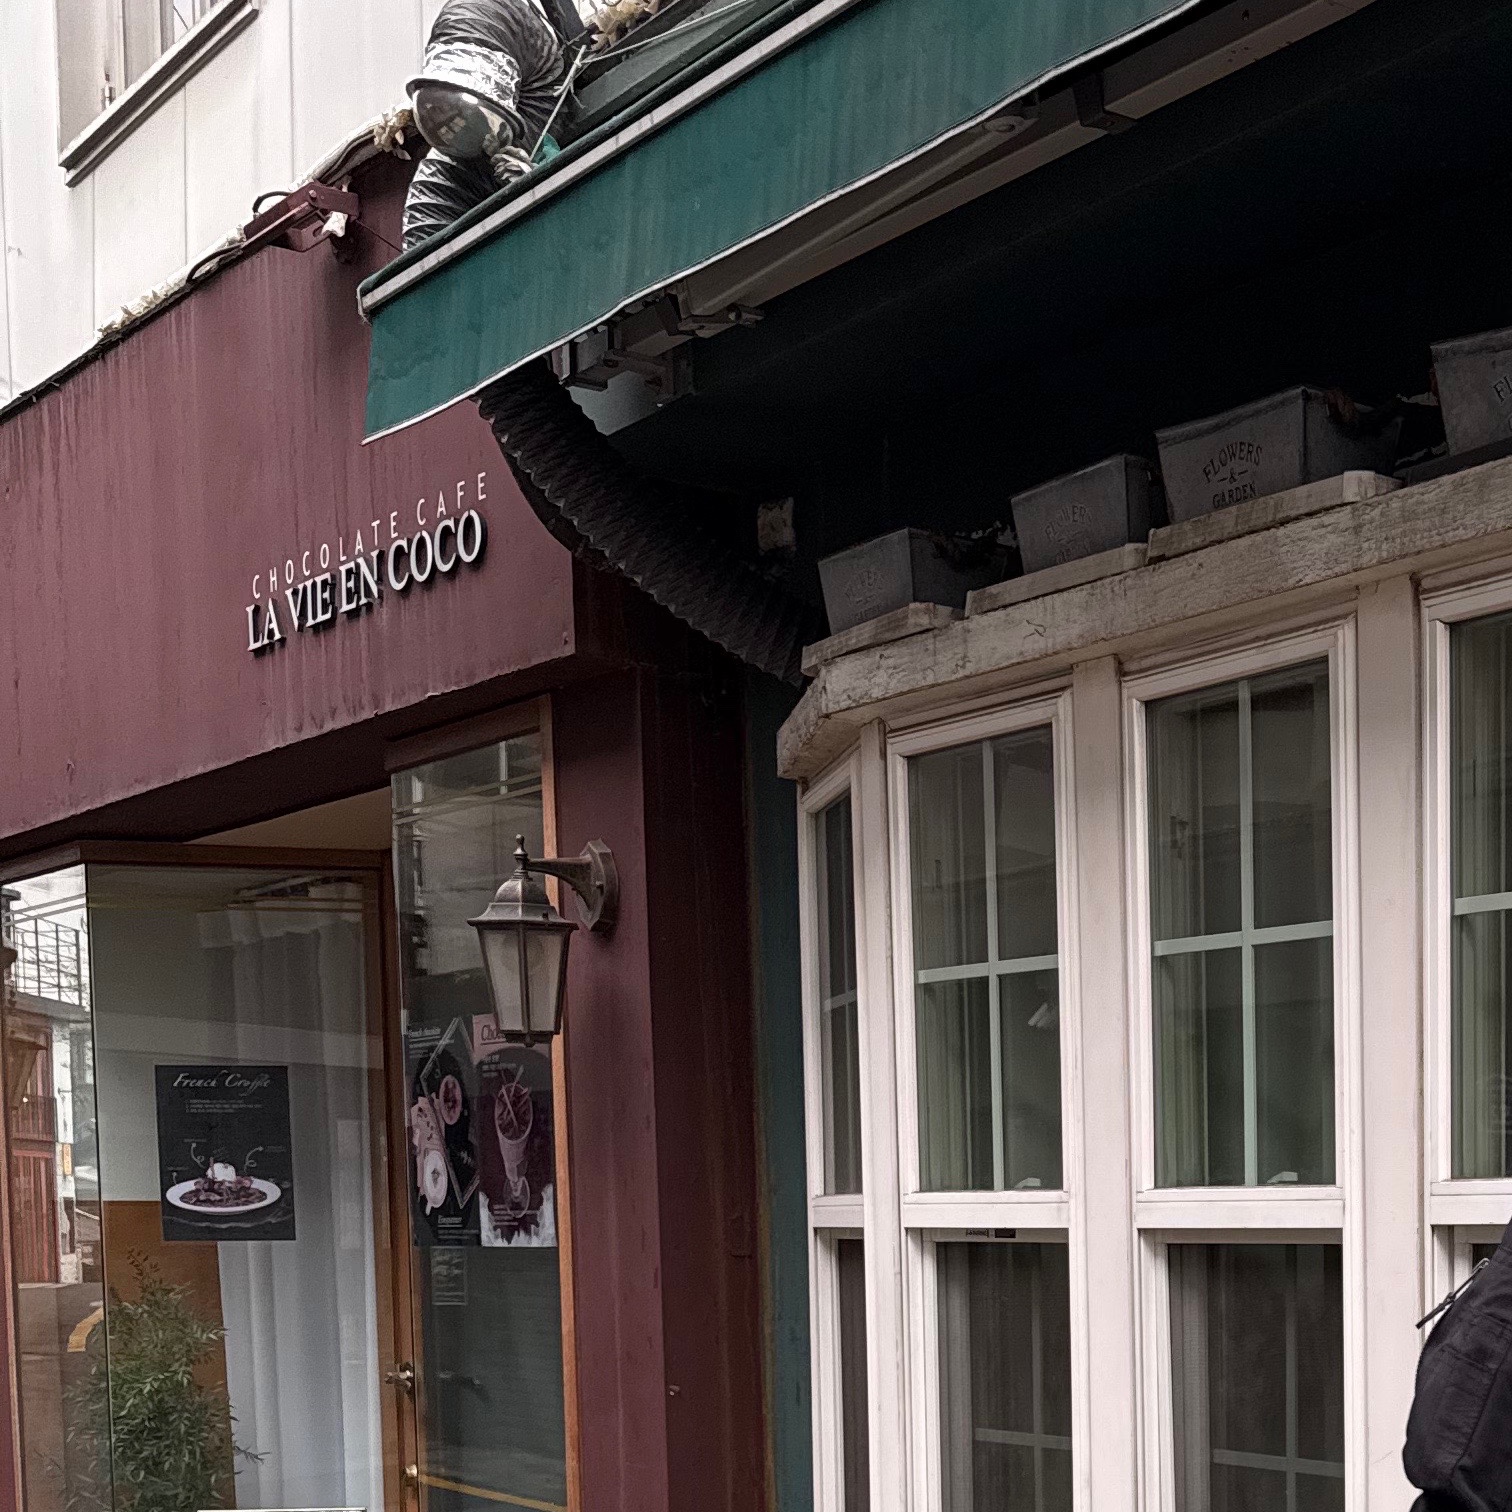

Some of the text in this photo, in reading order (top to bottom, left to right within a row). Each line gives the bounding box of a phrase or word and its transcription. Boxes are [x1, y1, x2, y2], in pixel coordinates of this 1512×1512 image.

[1202, 441, 1263, 484] FLOWERS
[1213, 480, 1258, 509] GARDEN
[252, 471, 487, 599] CHOCOLATE CAFE
[246, 509, 483, 652] LA VIE EN COCO
